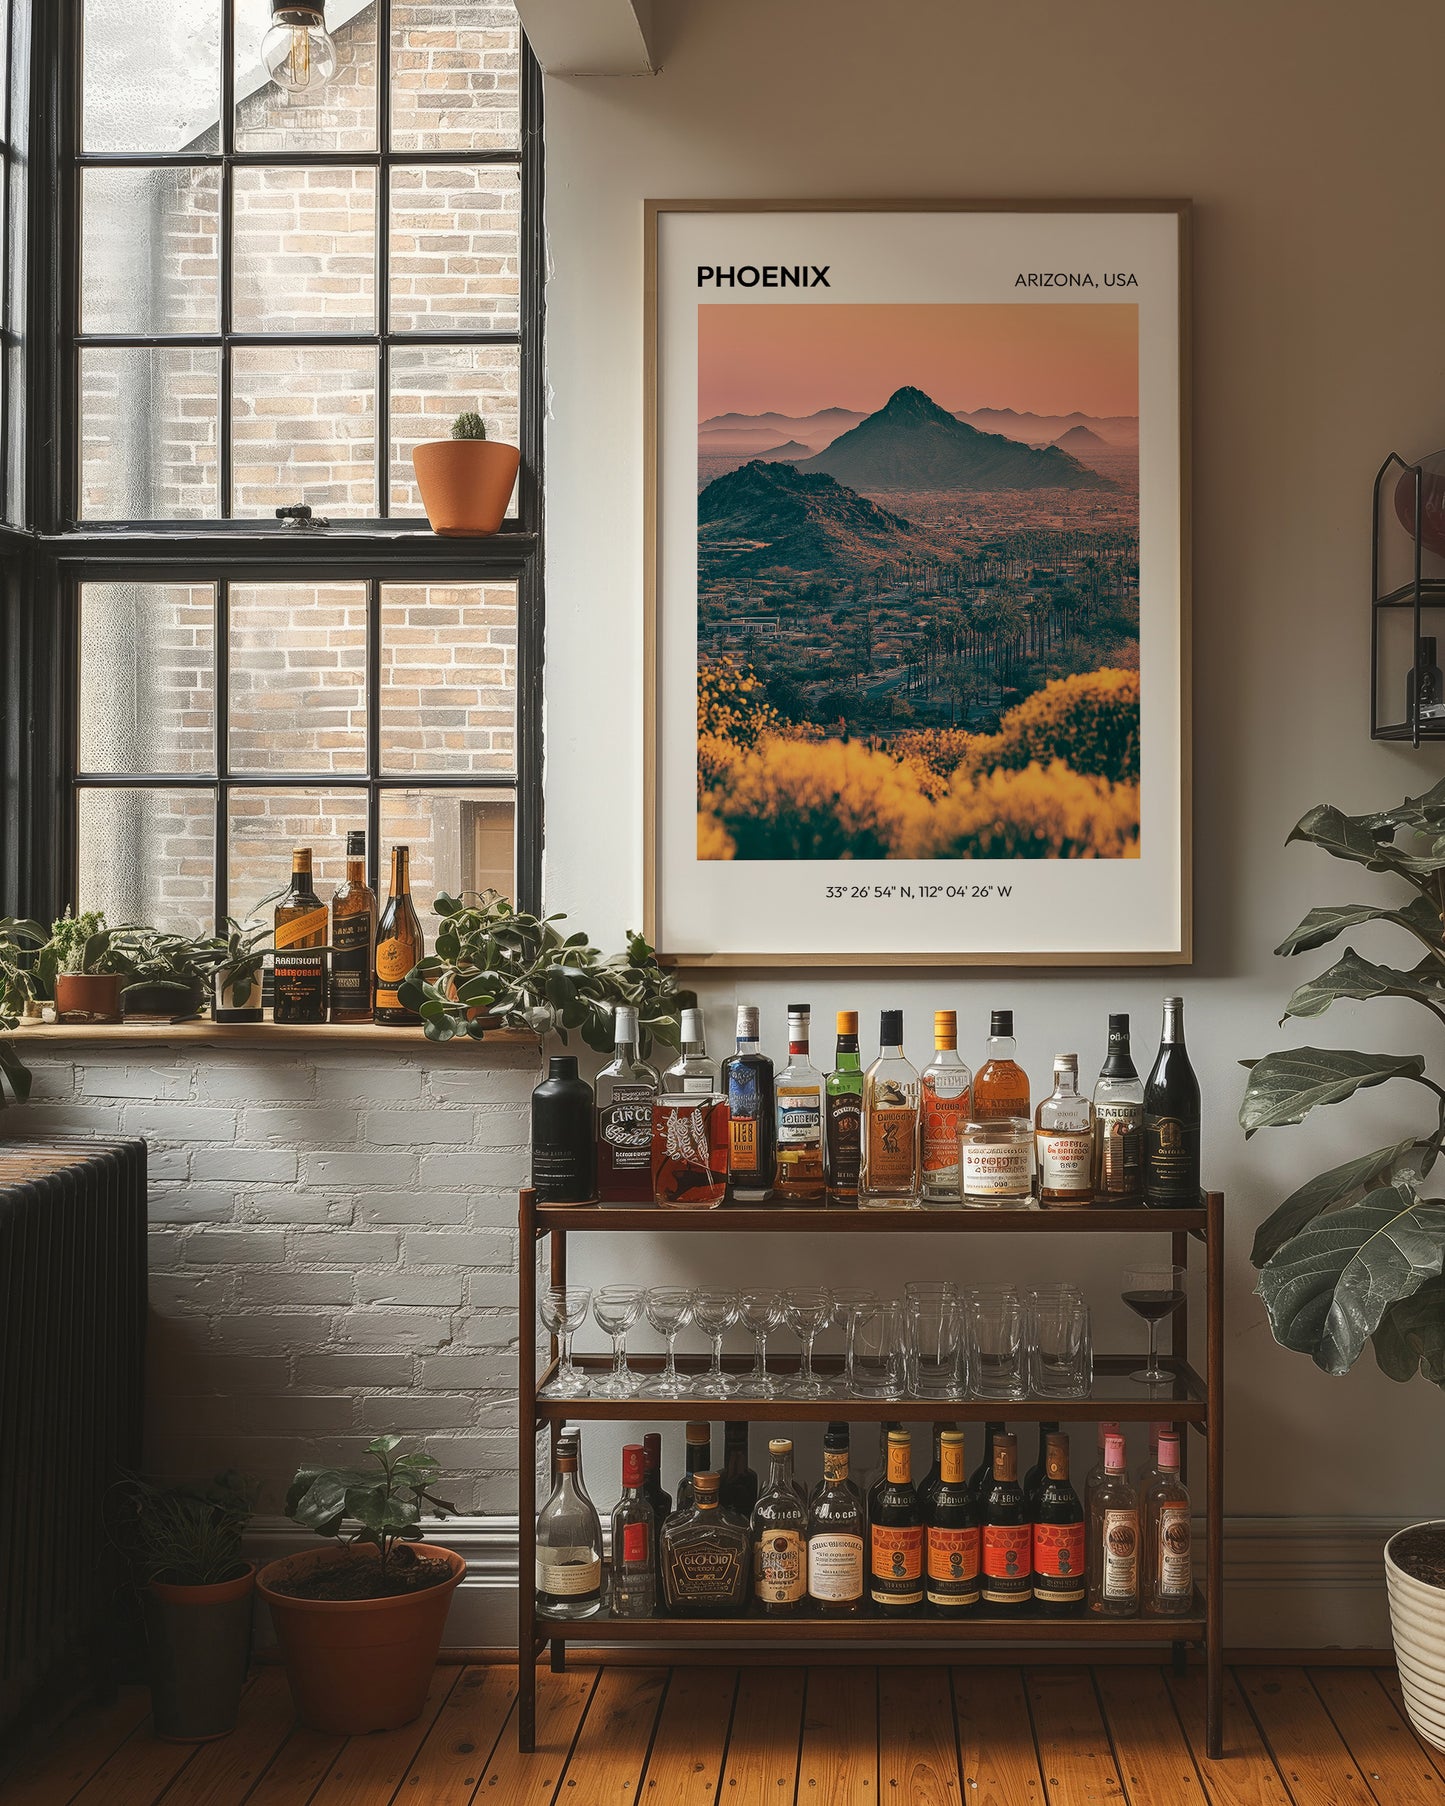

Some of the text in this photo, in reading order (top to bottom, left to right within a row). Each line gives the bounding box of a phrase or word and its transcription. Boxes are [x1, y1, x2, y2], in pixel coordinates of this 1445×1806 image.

[698, 266, 831, 288] PHOENIX
[1014, 272, 1139, 289] ARIZONA, USA
[900, 886, 916, 900] N,
[997, 885, 1013, 898] W
